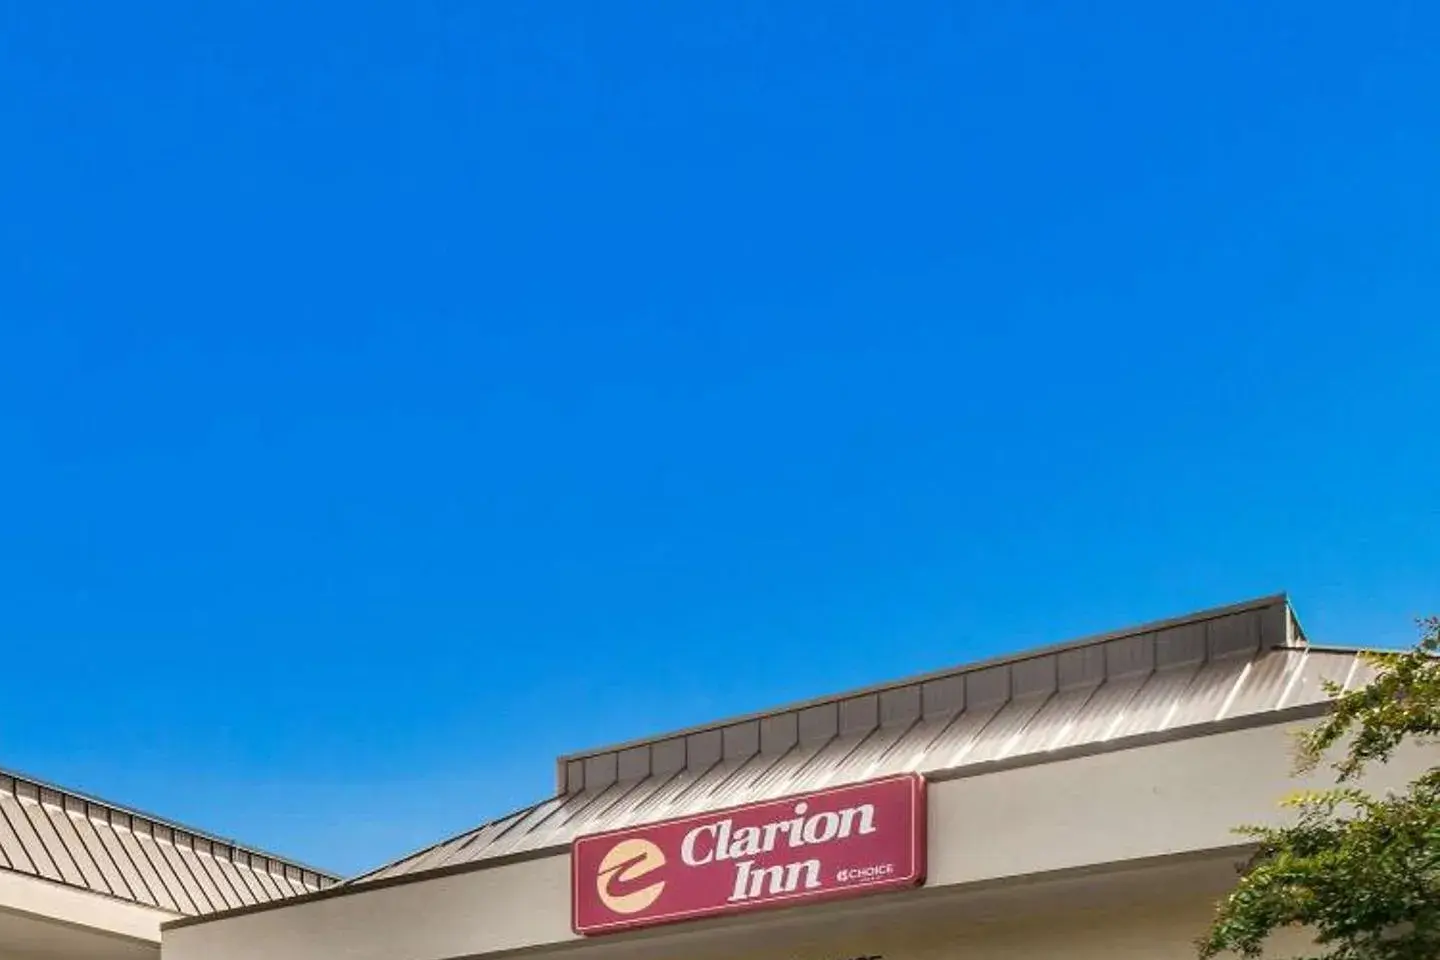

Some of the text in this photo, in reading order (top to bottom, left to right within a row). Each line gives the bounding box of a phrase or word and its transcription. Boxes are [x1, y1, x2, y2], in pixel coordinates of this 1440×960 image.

[680, 802, 877, 866] Clarion
[727, 859, 822, 901] Inn
[849, 863, 894, 879] CHOICE
